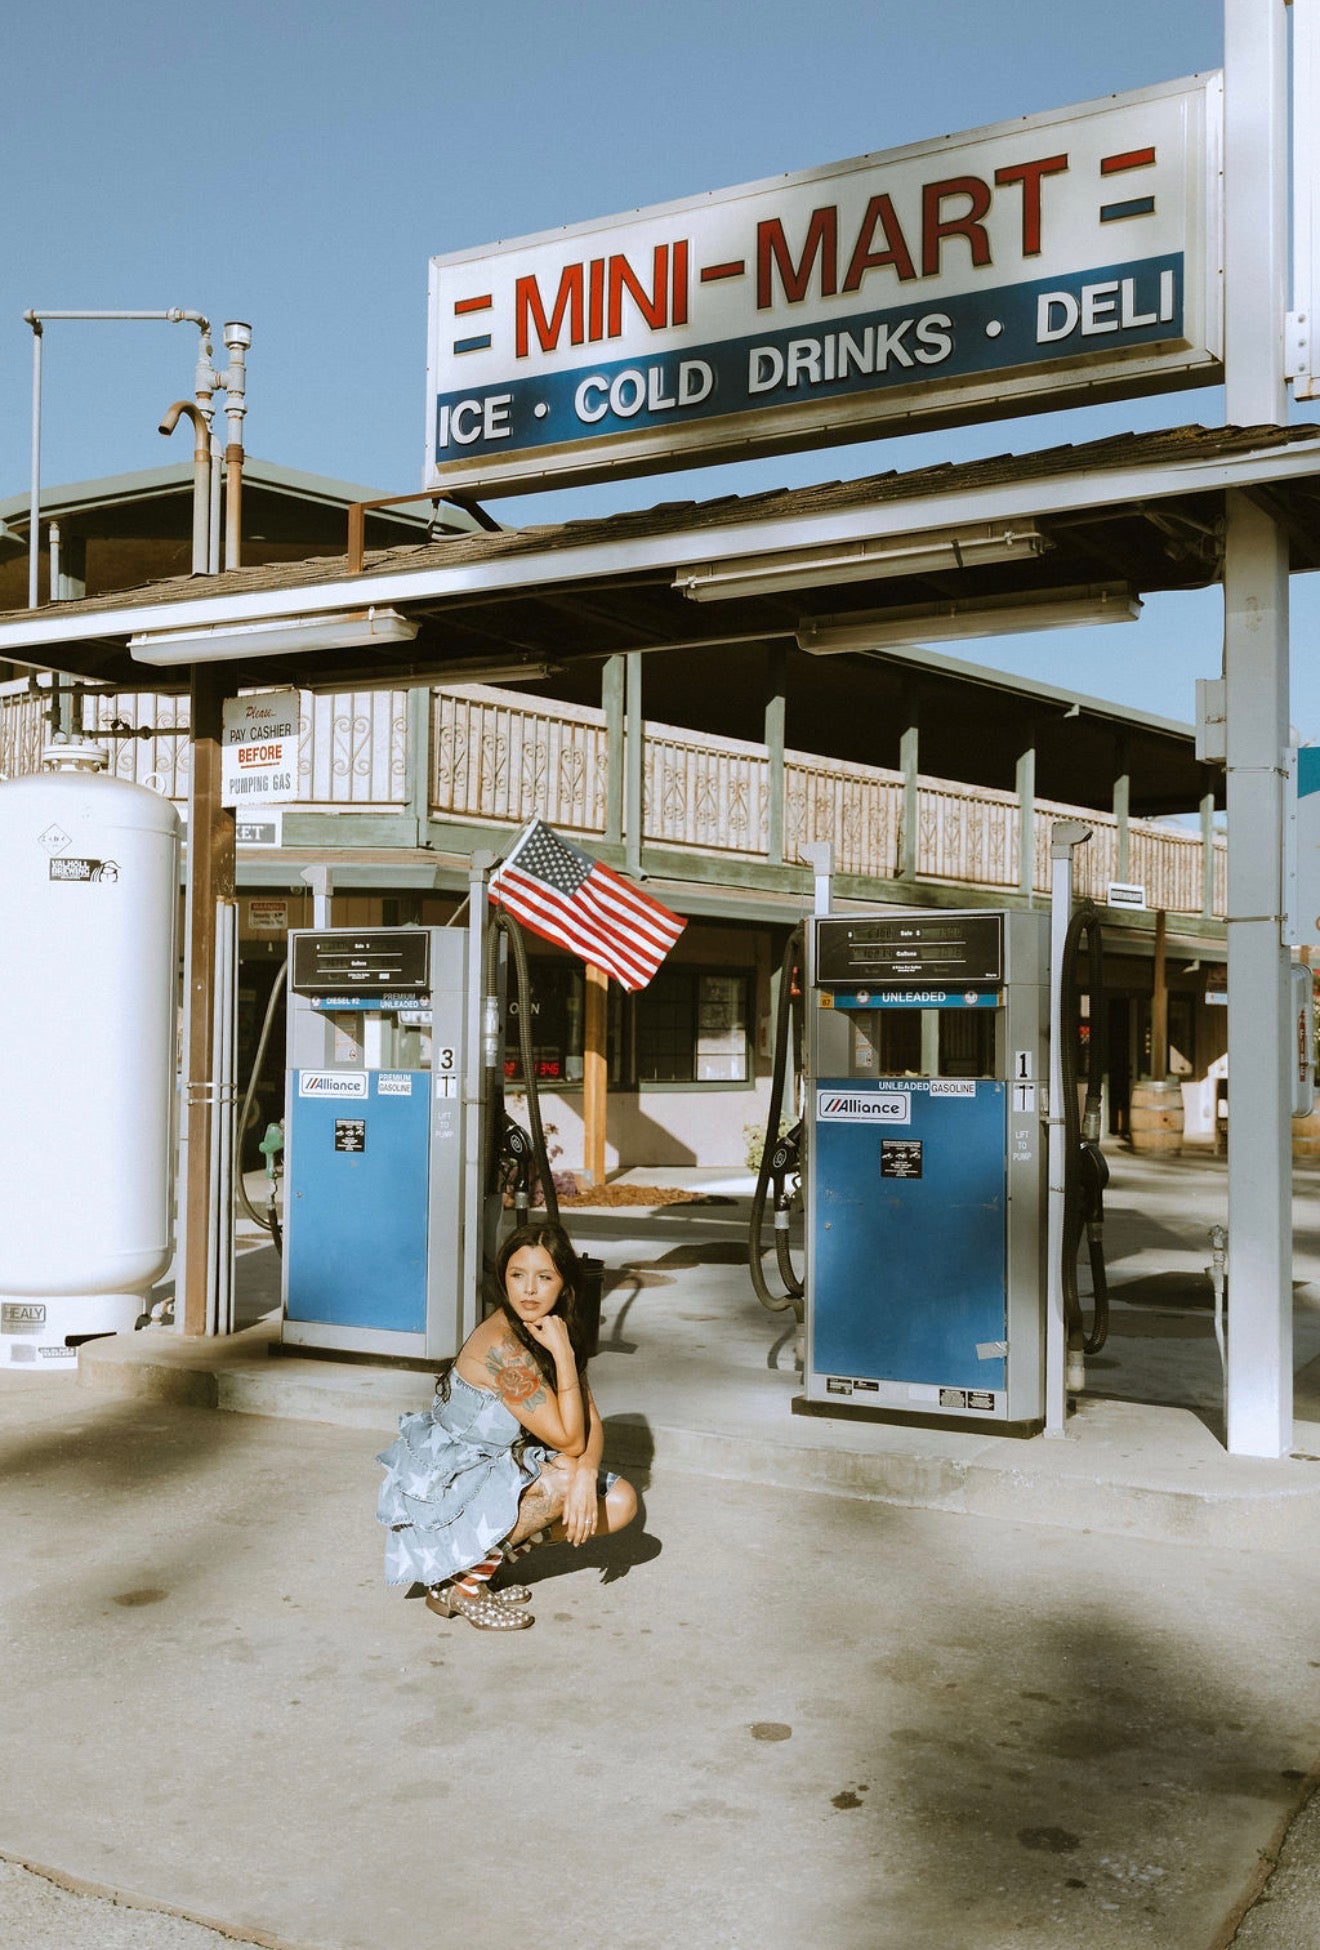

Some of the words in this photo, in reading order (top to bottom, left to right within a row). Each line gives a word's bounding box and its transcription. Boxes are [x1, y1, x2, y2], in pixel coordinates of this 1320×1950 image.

[514, 153, 1070, 359] MINI-MART
[439, 393, 513, 448] ICE
[574, 360, 714, 424] COLD
[747, 312, 954, 393] DRINKS
[1036, 269, 1175, 343] DELI
[230, 727, 246, 743] PAY
[250, 723, 292, 741] CASHIER
[238, 744, 282, 763] BEFORE
[229, 775, 269, 795] PUMPING
[272, 772, 291, 791] GAS
[326, 997, 349, 1005] DIESEL
[882, 991, 946, 1003] UNLEADED
[381, 1000, 419, 1009] UNLEADED
[441, 1049, 454, 1070] 3
[1019, 1053, 1028, 1078] 1
[315, 1077, 361, 1092] Alliance
[379, 1074, 412, 1083] PREMIUM
[379, 1083, 411, 1093] GASOLINE
[878, 1081, 929, 1092] UNLEADED
[931, 1083, 975, 1093] GASOLINE
[837, 1099, 900, 1115] Alliance
[1015, 1130, 1029, 1139] LIFT
[1018, 1141, 1027, 1149] TO
[1013, 1152, 1032, 1161] PUMP
